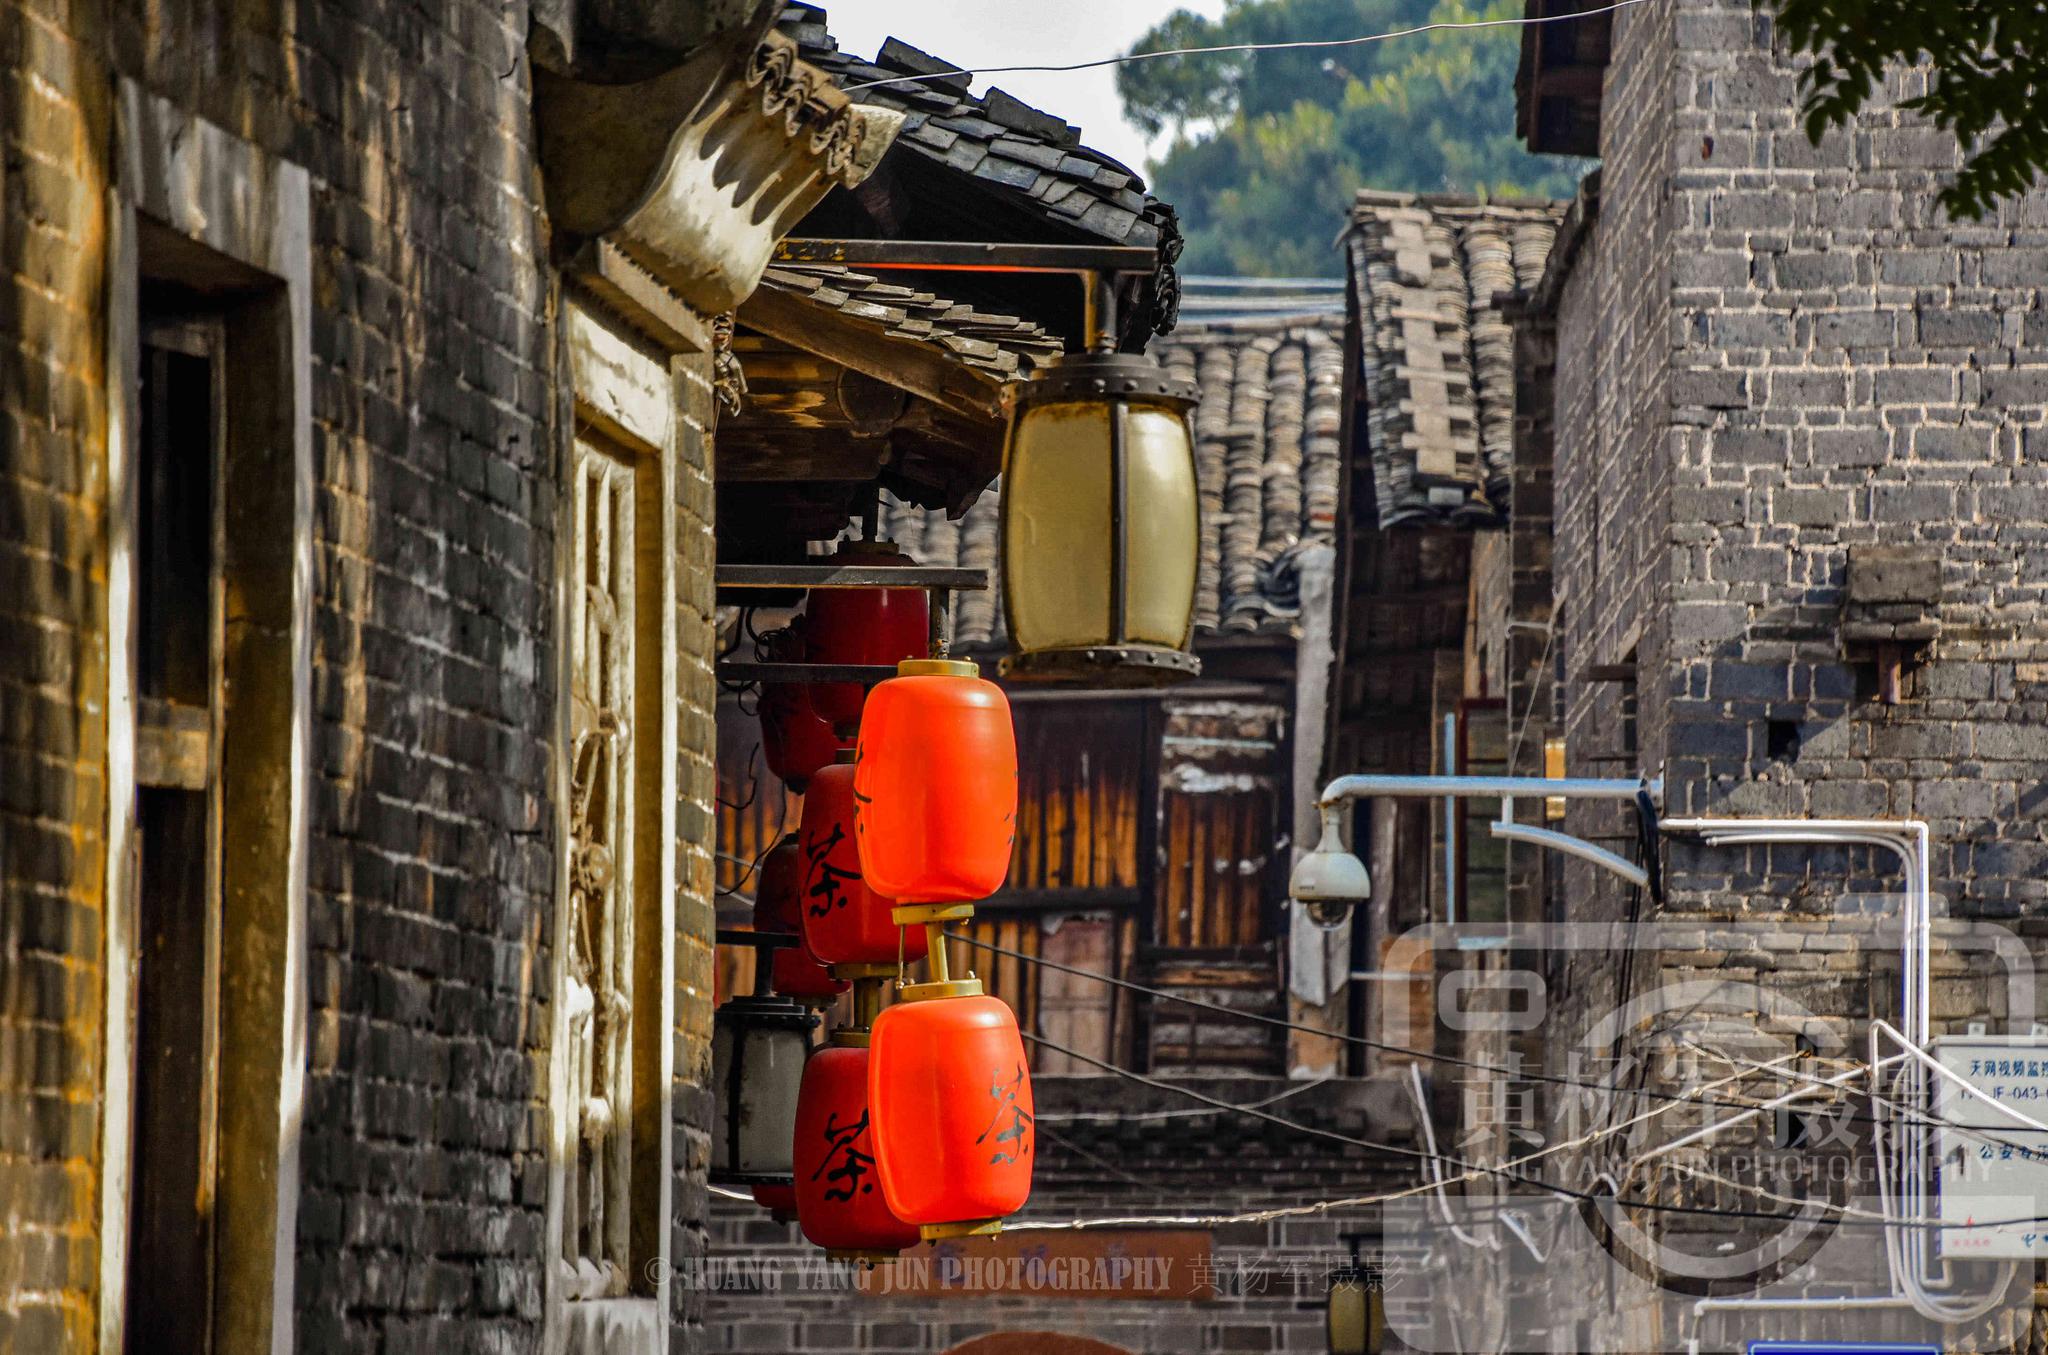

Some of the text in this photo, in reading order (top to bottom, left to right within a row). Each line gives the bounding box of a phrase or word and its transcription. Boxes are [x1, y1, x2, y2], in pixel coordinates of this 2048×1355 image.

[803, 823, 863, 917] 茶
[811, 1107, 876, 1201] 茶
[975, 1062, 1033, 1164] 茶
